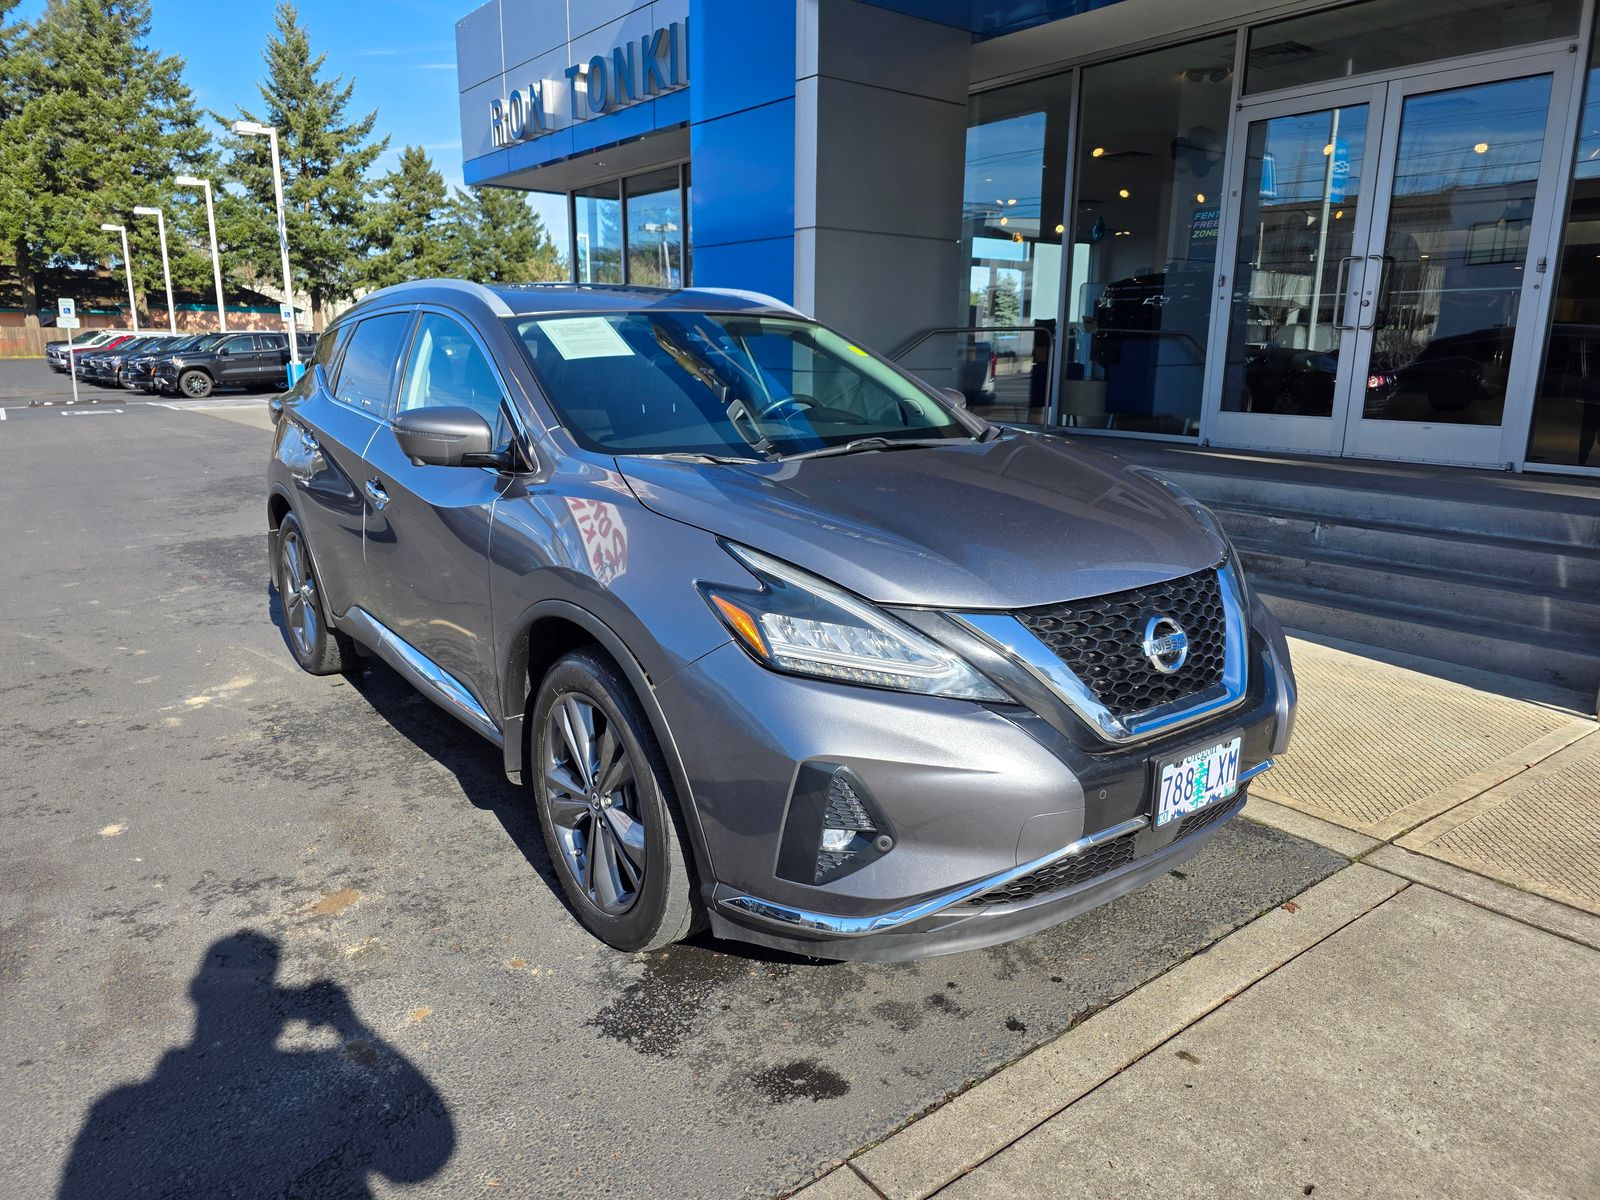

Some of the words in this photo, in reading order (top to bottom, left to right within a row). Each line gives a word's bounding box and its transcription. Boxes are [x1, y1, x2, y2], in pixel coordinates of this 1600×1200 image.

[489, 79, 548, 147] RON
[565, 16, 689, 120] TONKI
[1191, 229, 1219, 238] ZONE
[1192, 220, 1220, 229] FREE
[1163, 767, 1195, 810] 788
[1205, 748, 1238, 792] LXM
